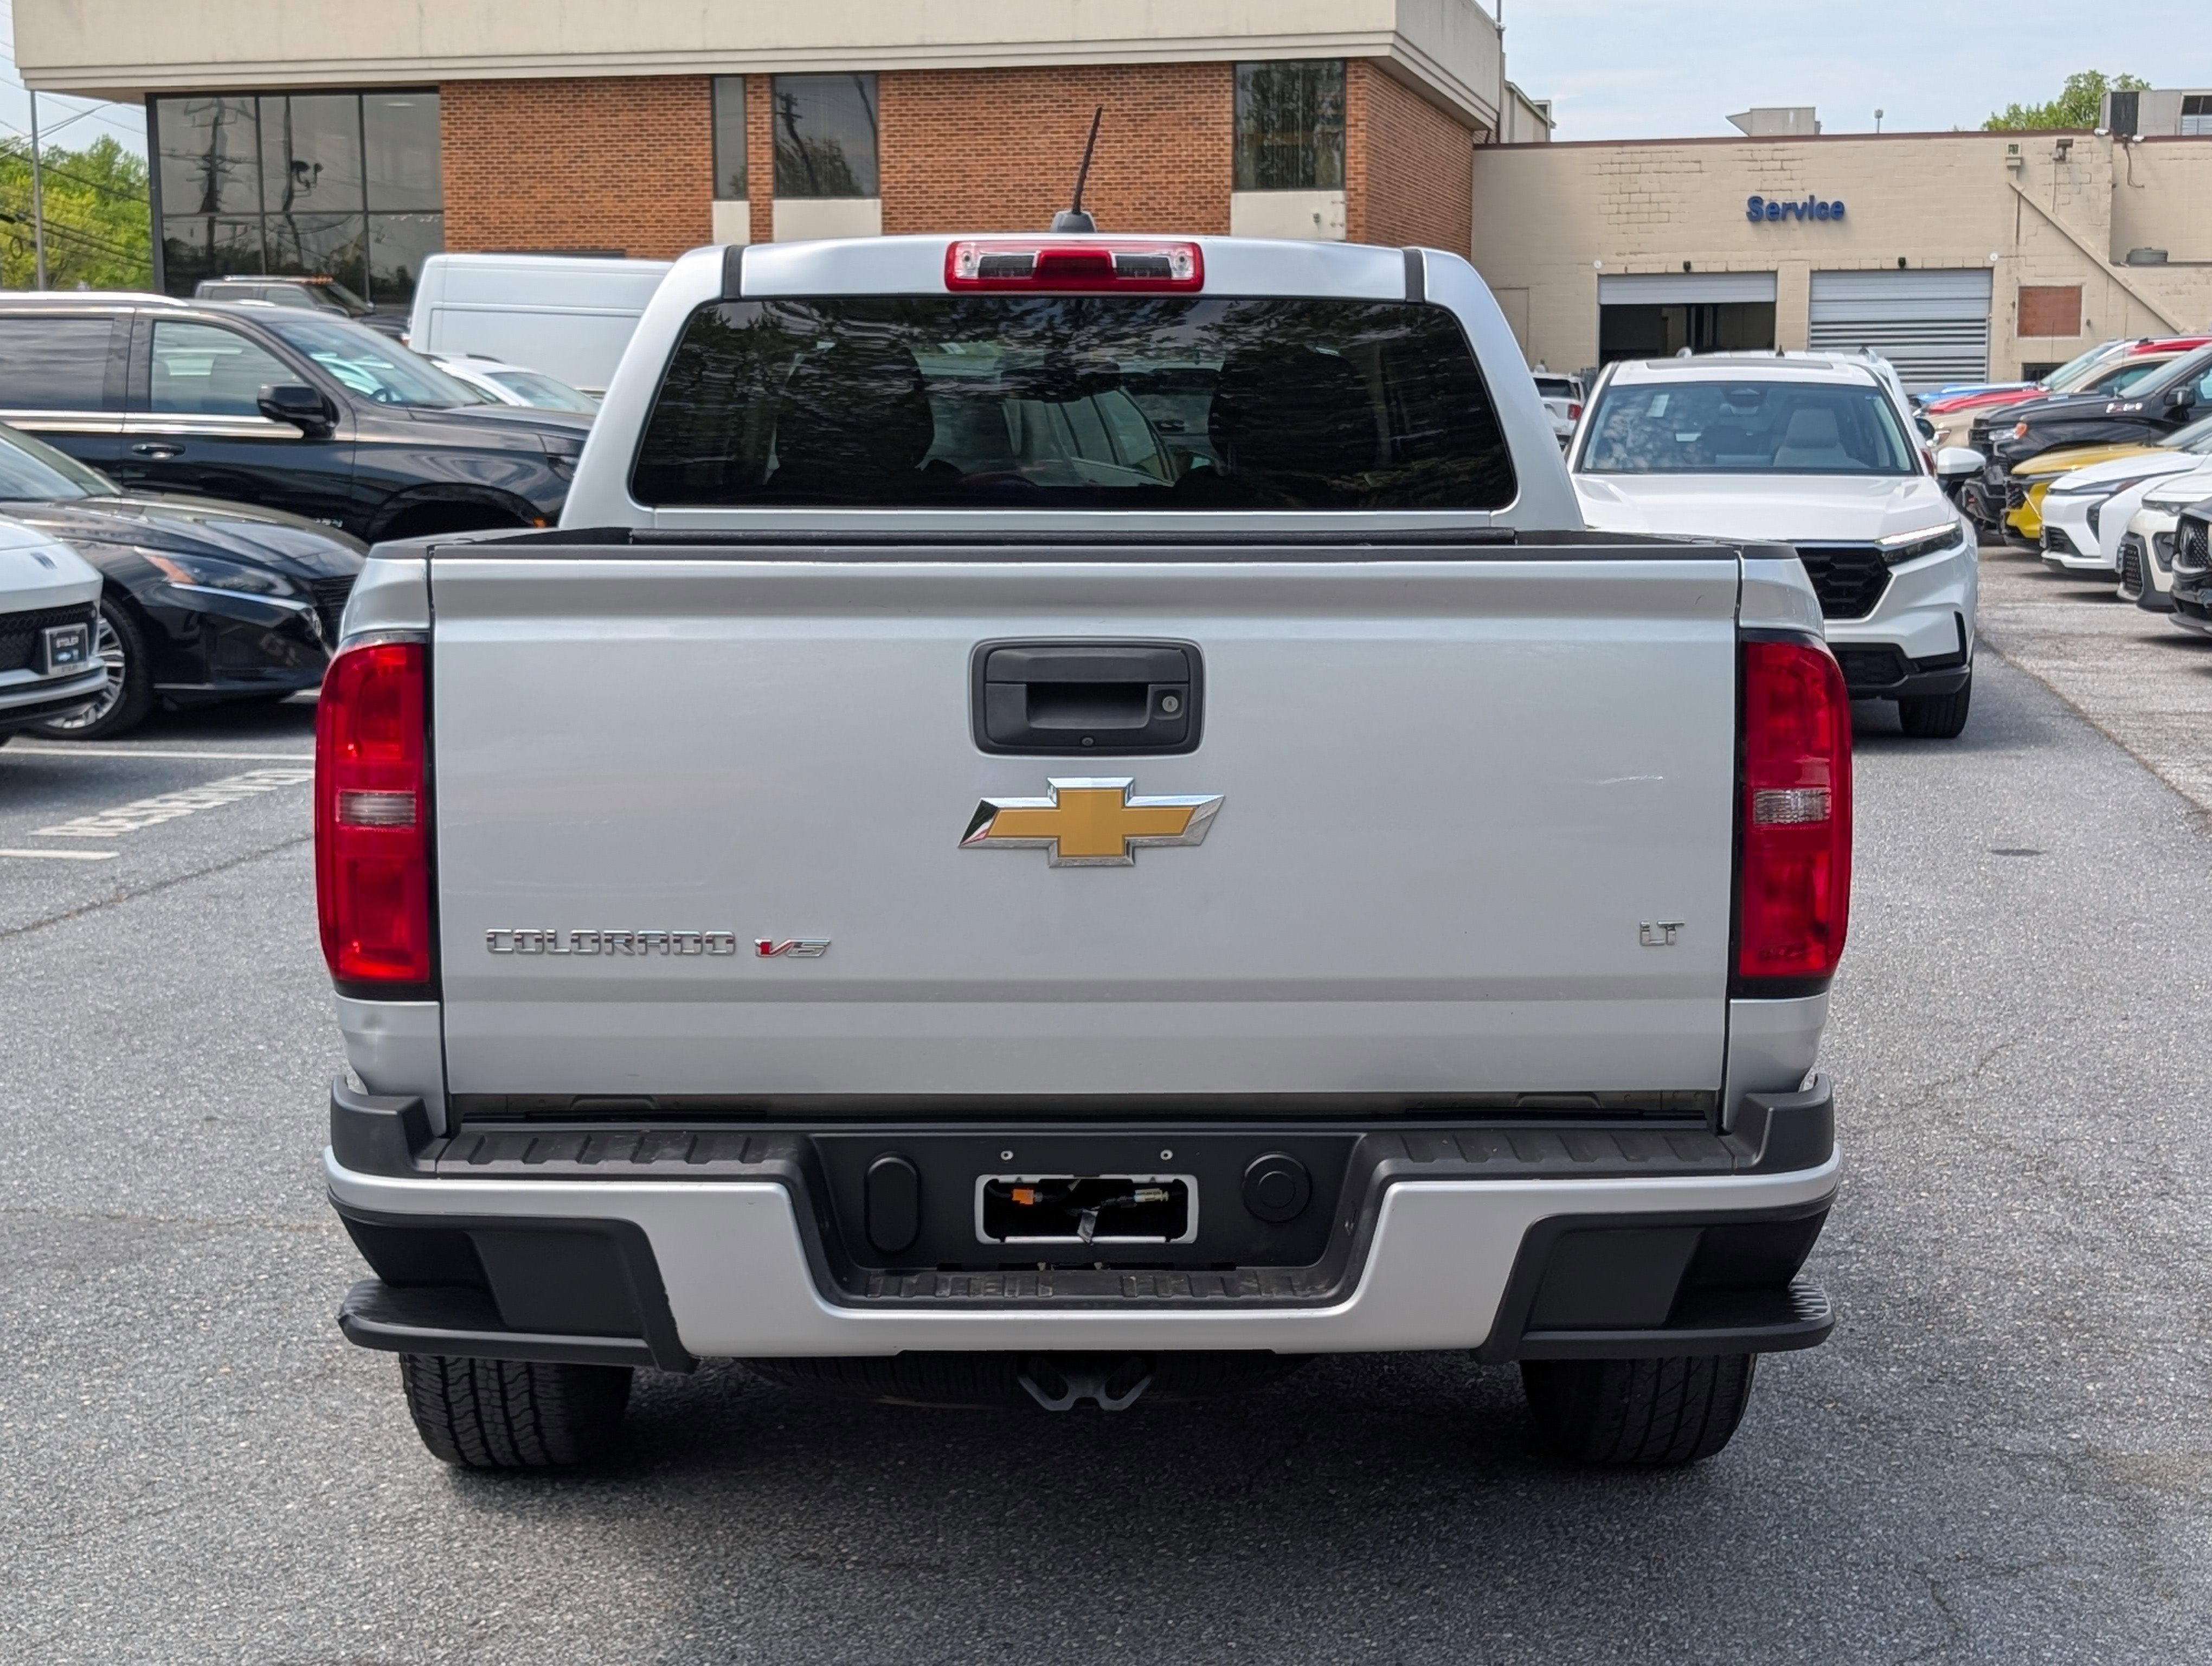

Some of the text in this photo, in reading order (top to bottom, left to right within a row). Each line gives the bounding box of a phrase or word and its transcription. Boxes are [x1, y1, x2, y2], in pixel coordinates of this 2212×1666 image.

[1746, 194, 1845, 222] Service
[486, 928, 832, 958] COLORADO V6
[1640, 921, 1685, 946] LT
